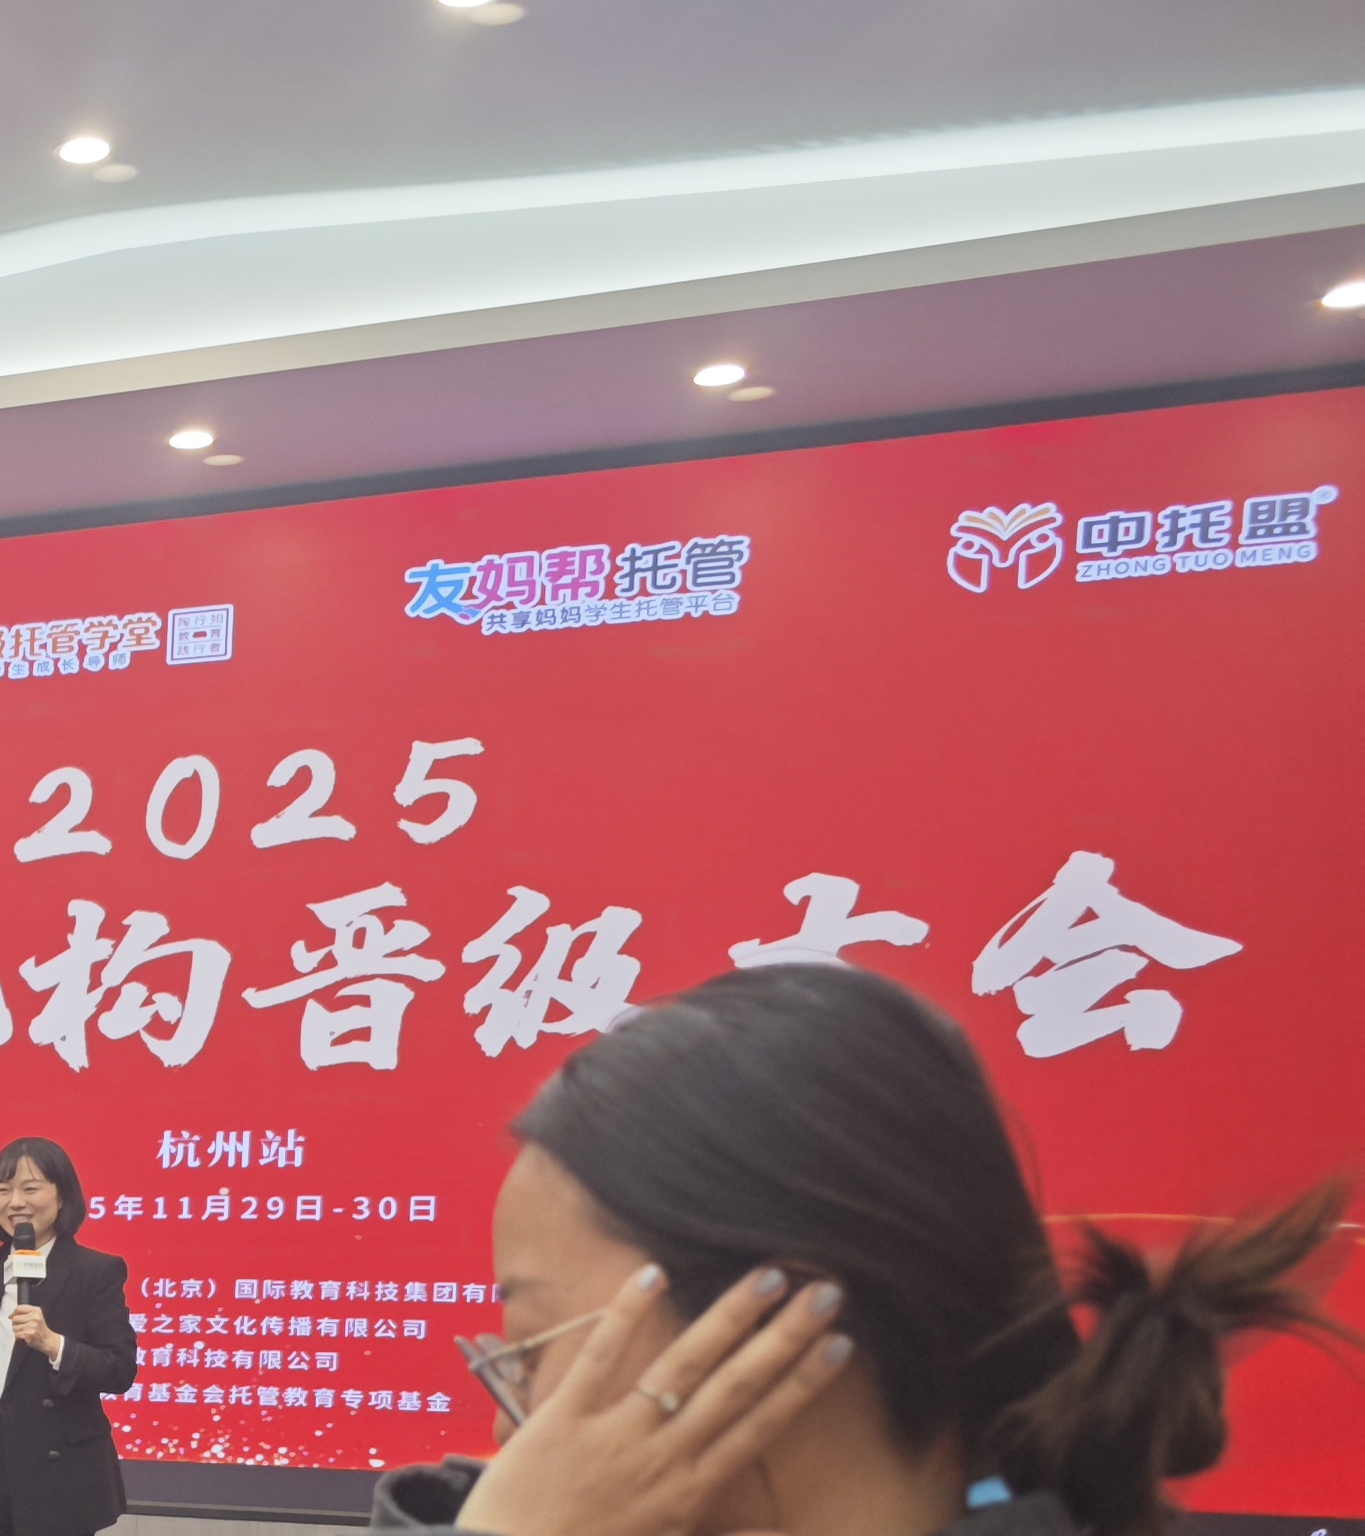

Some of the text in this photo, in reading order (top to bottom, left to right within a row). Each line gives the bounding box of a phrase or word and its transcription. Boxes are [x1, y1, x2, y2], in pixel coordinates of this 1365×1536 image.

[1081, 497, 1311, 553] 中托盟
[408, 538, 746, 613] 友妈帮托管
[1081, 545, 1311, 578] ZHONG TUO MENG
[486, 593, 735, 630] 共享妈妈学生托管平台
[14, 738, 484, 863] 2025
[156, 1129, 306, 1169] 杭州站
[88, 1194, 438, 1222] 5年11月29日-30日
[129, 1313, 427, 1340] 爱之家文化传播有限公司
